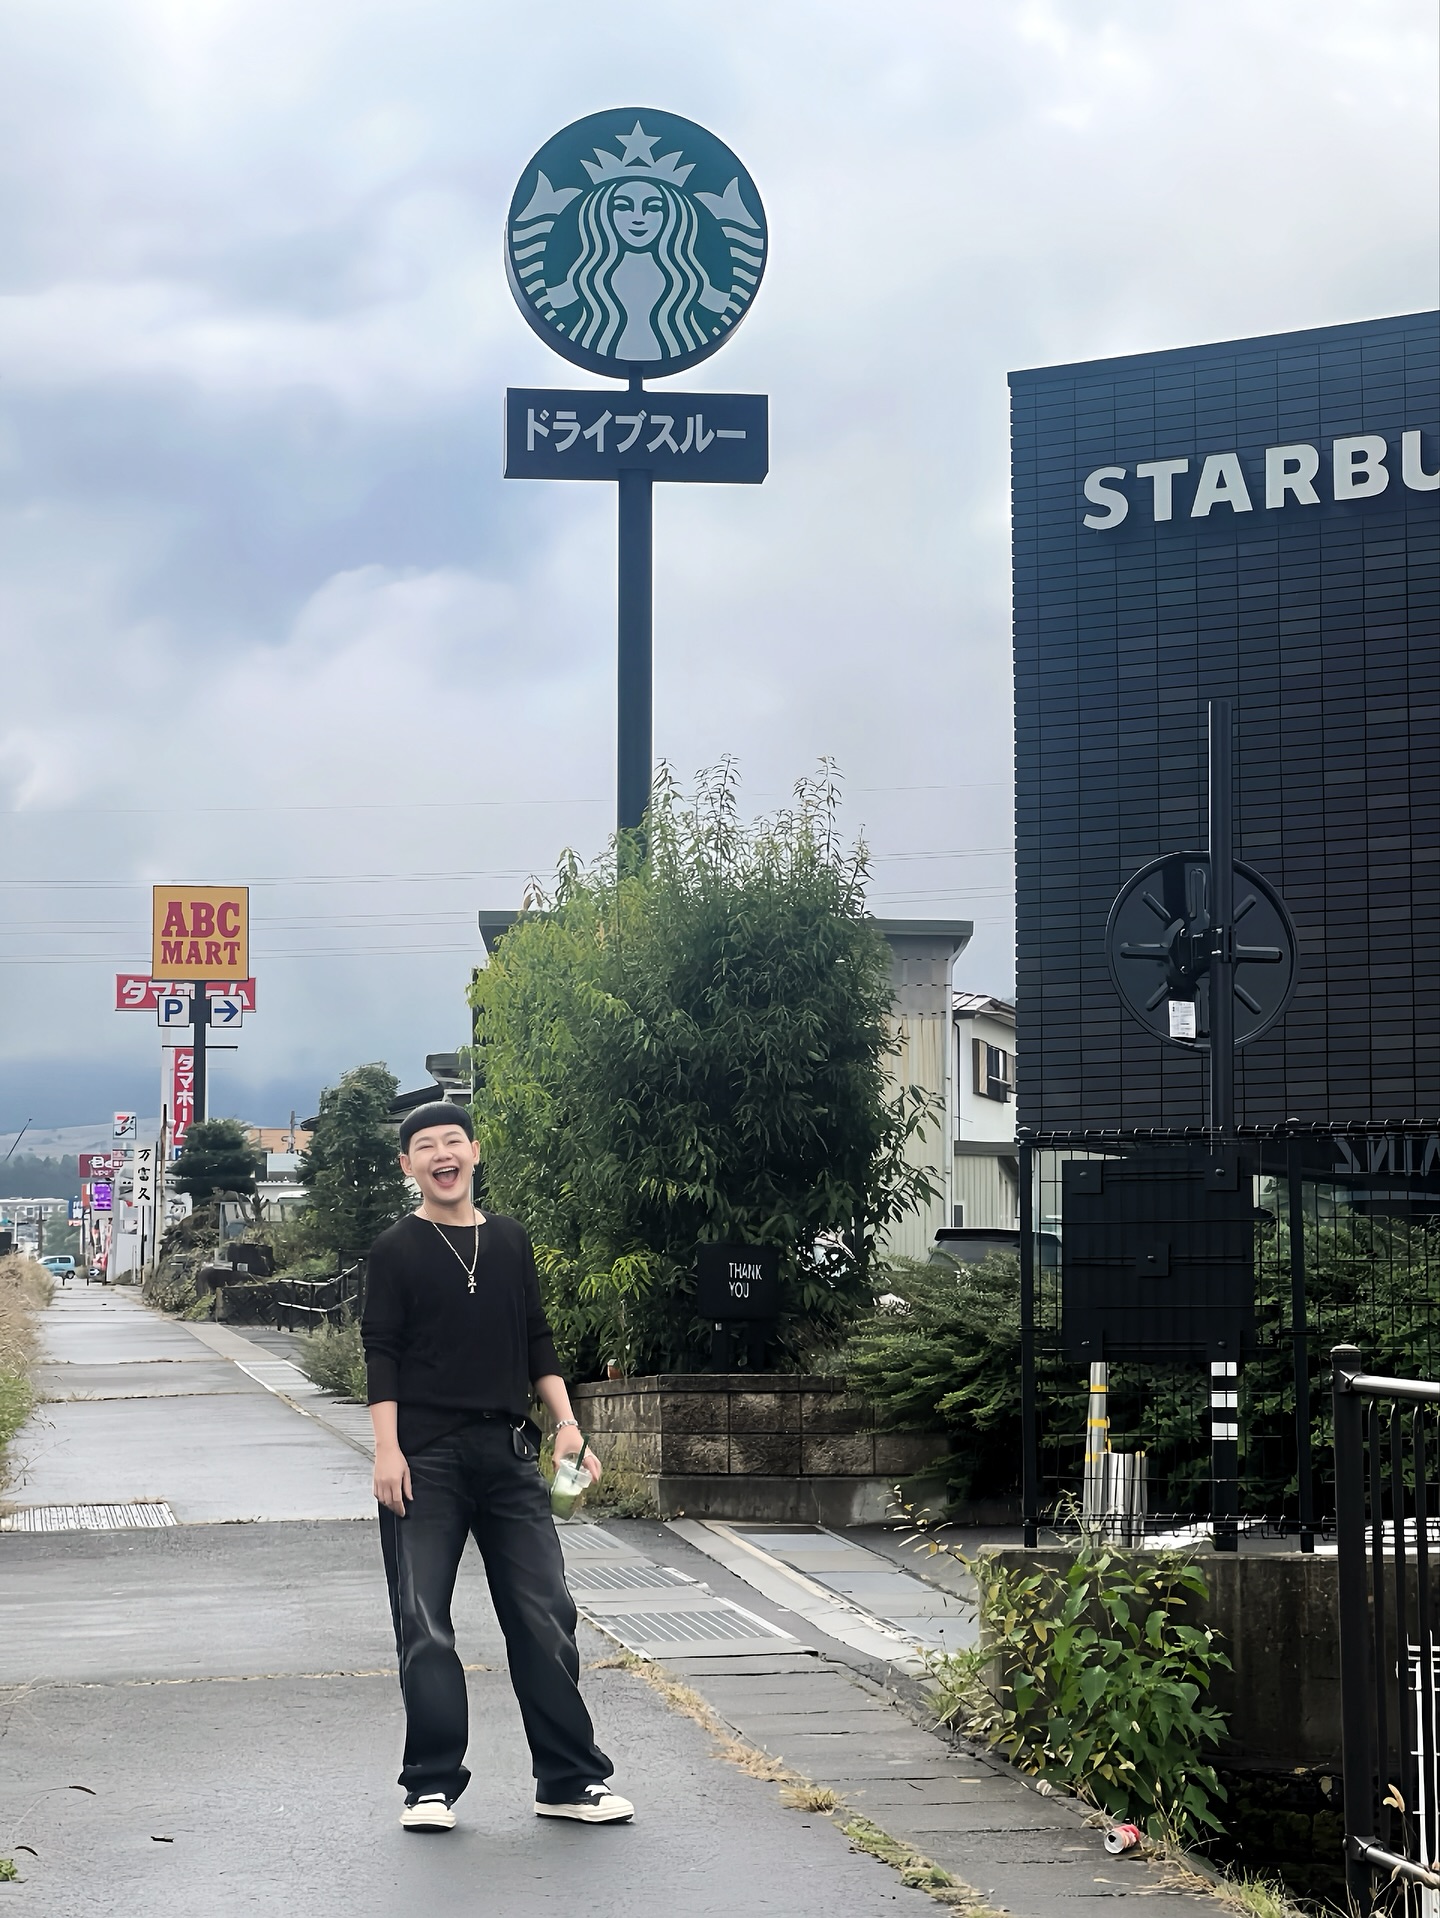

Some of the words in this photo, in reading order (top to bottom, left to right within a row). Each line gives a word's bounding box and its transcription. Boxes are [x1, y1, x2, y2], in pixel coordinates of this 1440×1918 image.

[527, 408, 747, 454] ドライブスルー
[1083, 430, 1440, 531] STARBU
[161, 901, 241, 938] ABC
[161, 940, 241, 966] MART
[164, 998, 183, 1023] P
[728, 1262, 763, 1280] THANK
[728, 1281, 750, 1298] YOU
